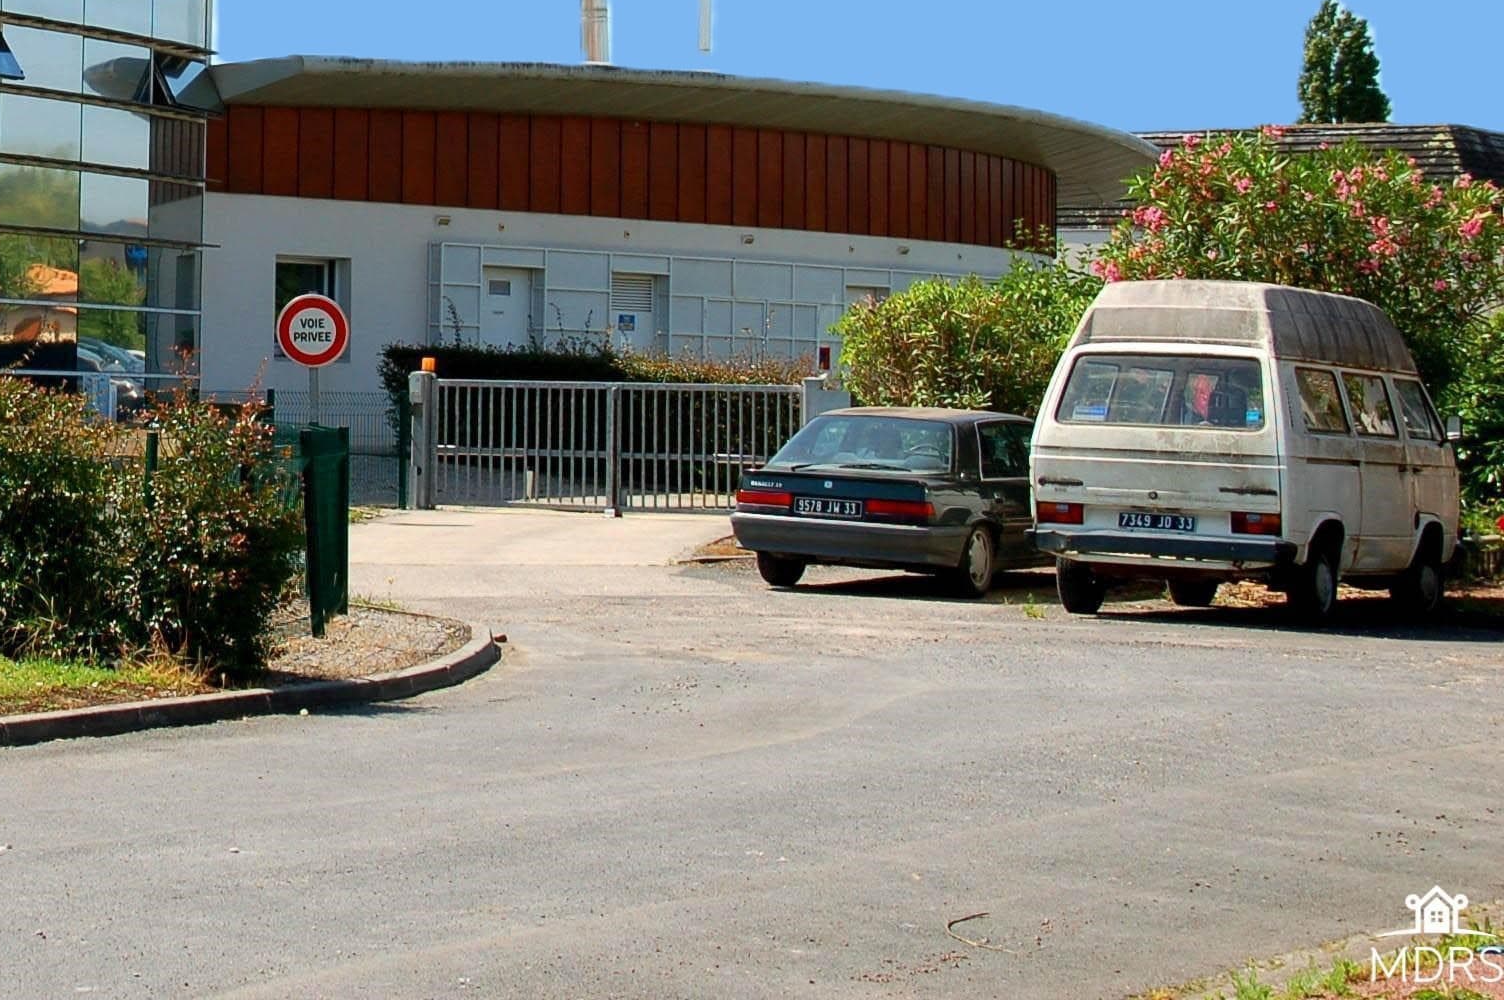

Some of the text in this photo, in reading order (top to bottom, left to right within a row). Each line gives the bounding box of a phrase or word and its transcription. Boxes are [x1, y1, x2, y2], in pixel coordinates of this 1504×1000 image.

[299, 318, 325, 329] VOIE
[293, 331, 332, 342] PRIVEE
[799, 499, 822, 512] 9578
[844, 502, 856, 514] 33
[1121, 513, 1151, 527] 7349
[1178, 517, 1193, 530] 33
